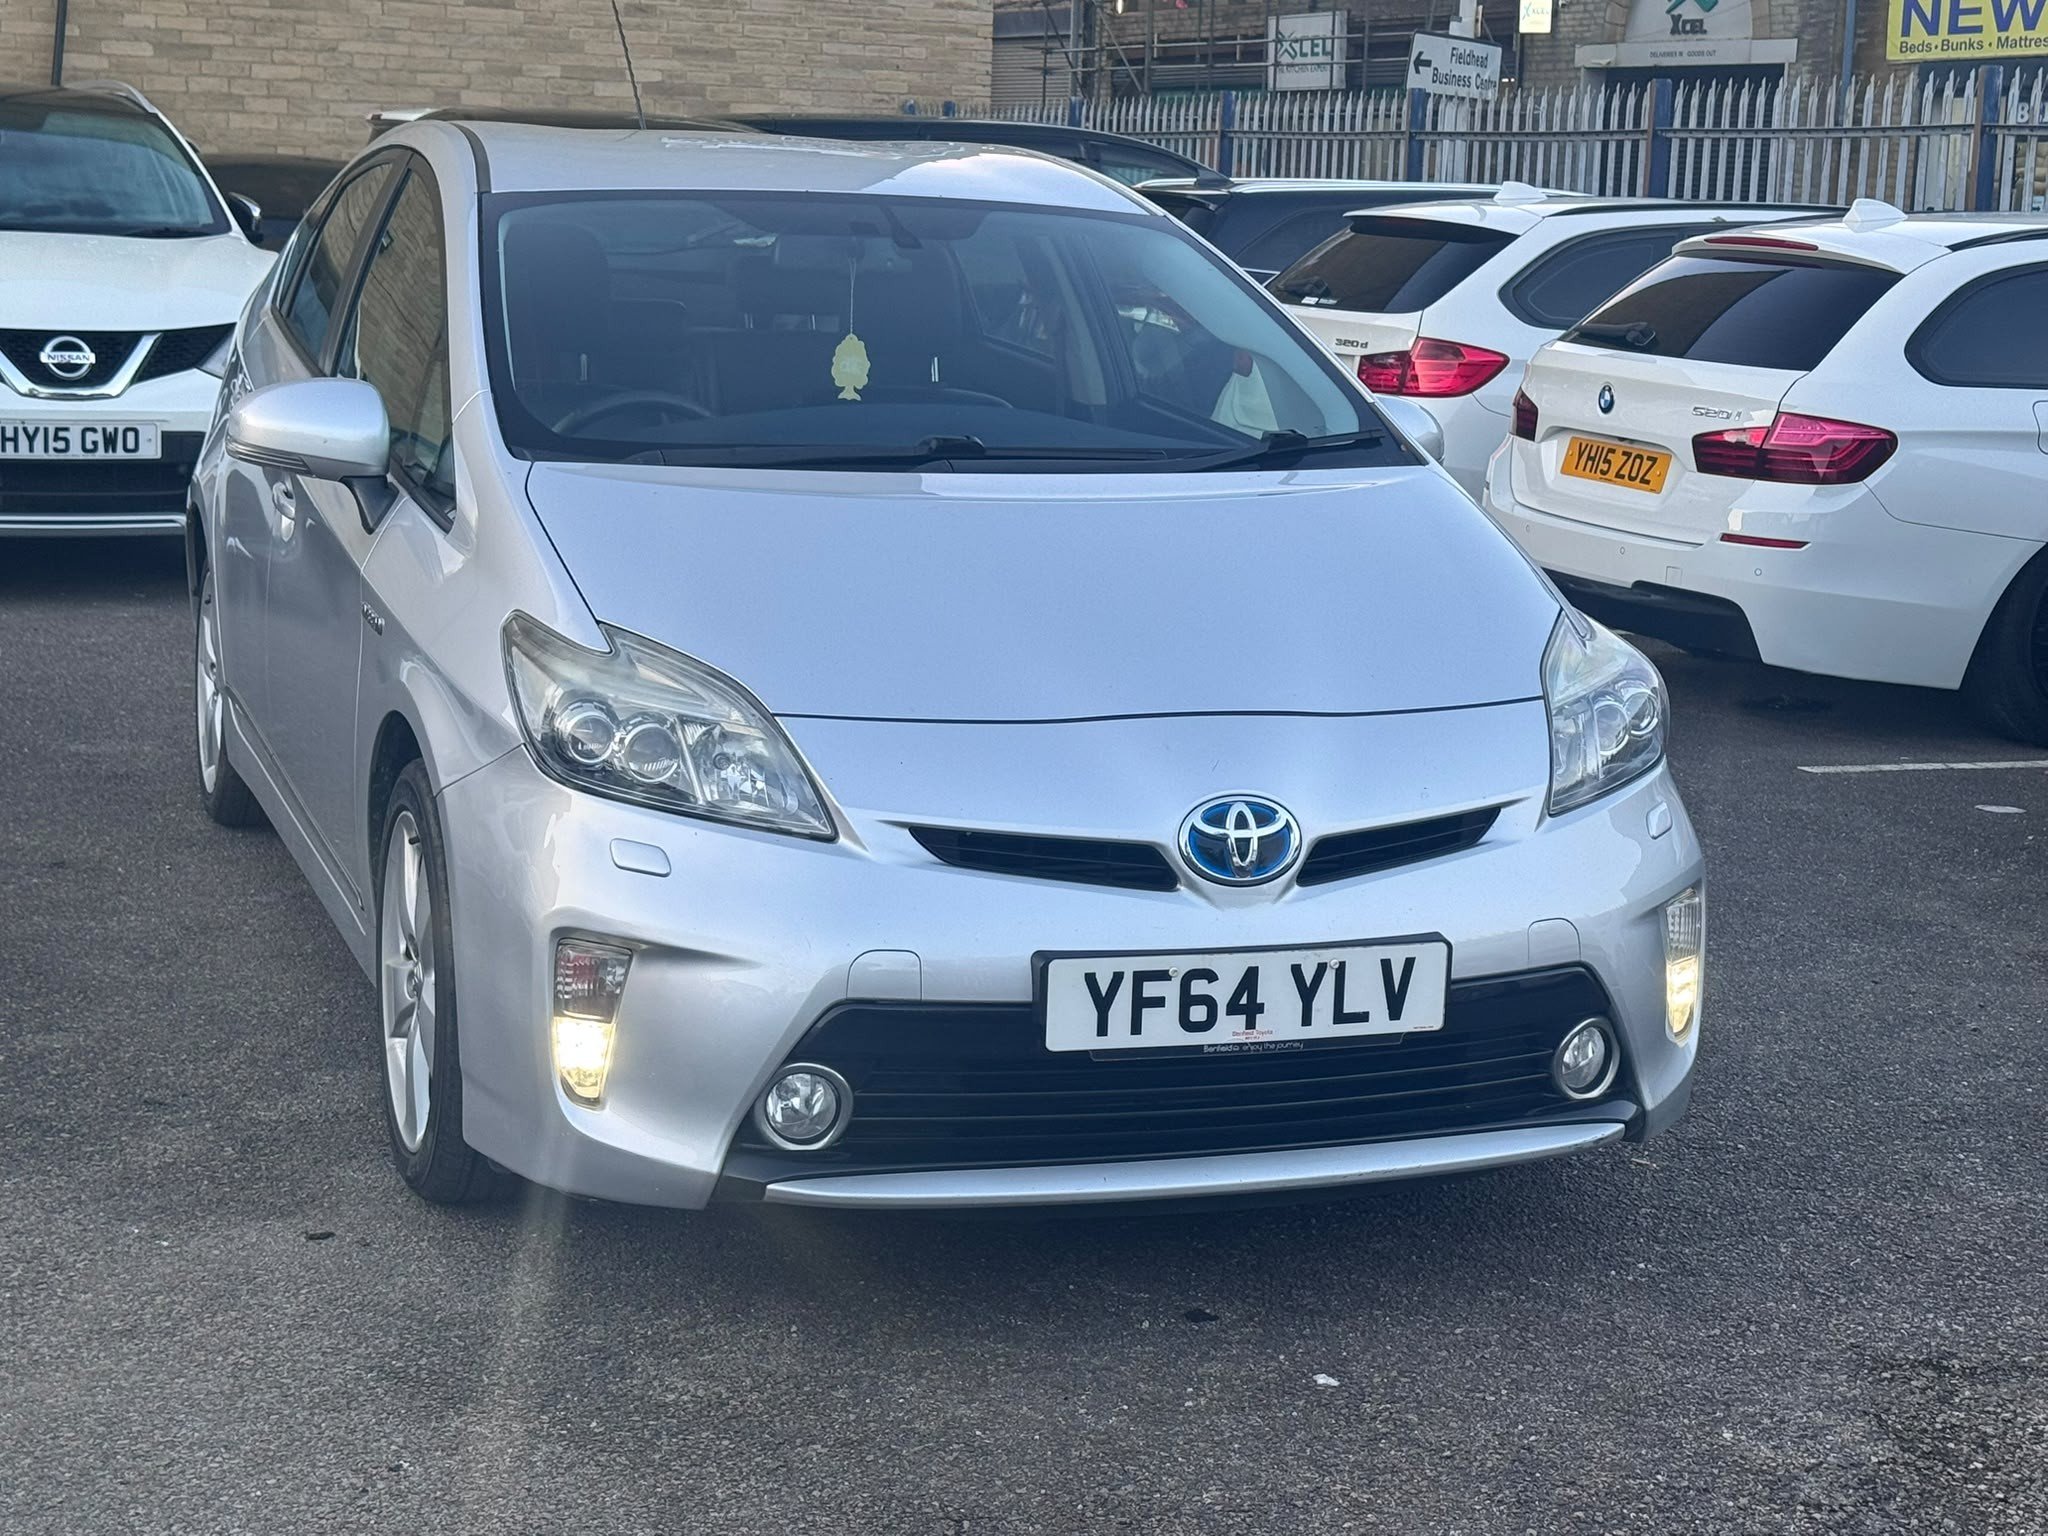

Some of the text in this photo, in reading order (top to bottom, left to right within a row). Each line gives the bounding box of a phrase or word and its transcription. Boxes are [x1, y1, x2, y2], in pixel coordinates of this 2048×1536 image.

[1901, 0, 2047, 37] NEW
[1450, 46, 1488, 69] Fieldhead
[1900, 41, 1932, 53] Beds
[1941, 38, 1984, 51] Bunks
[1431, 66, 1497, 91] Business Centre
[47, 353, 90, 361] NISSAN
[0, 426, 140, 454] HY15 GWO
[1574, 442, 1659, 486] YH15 ZOZ
[1084, 957, 1417, 1037] YF64 YLV
